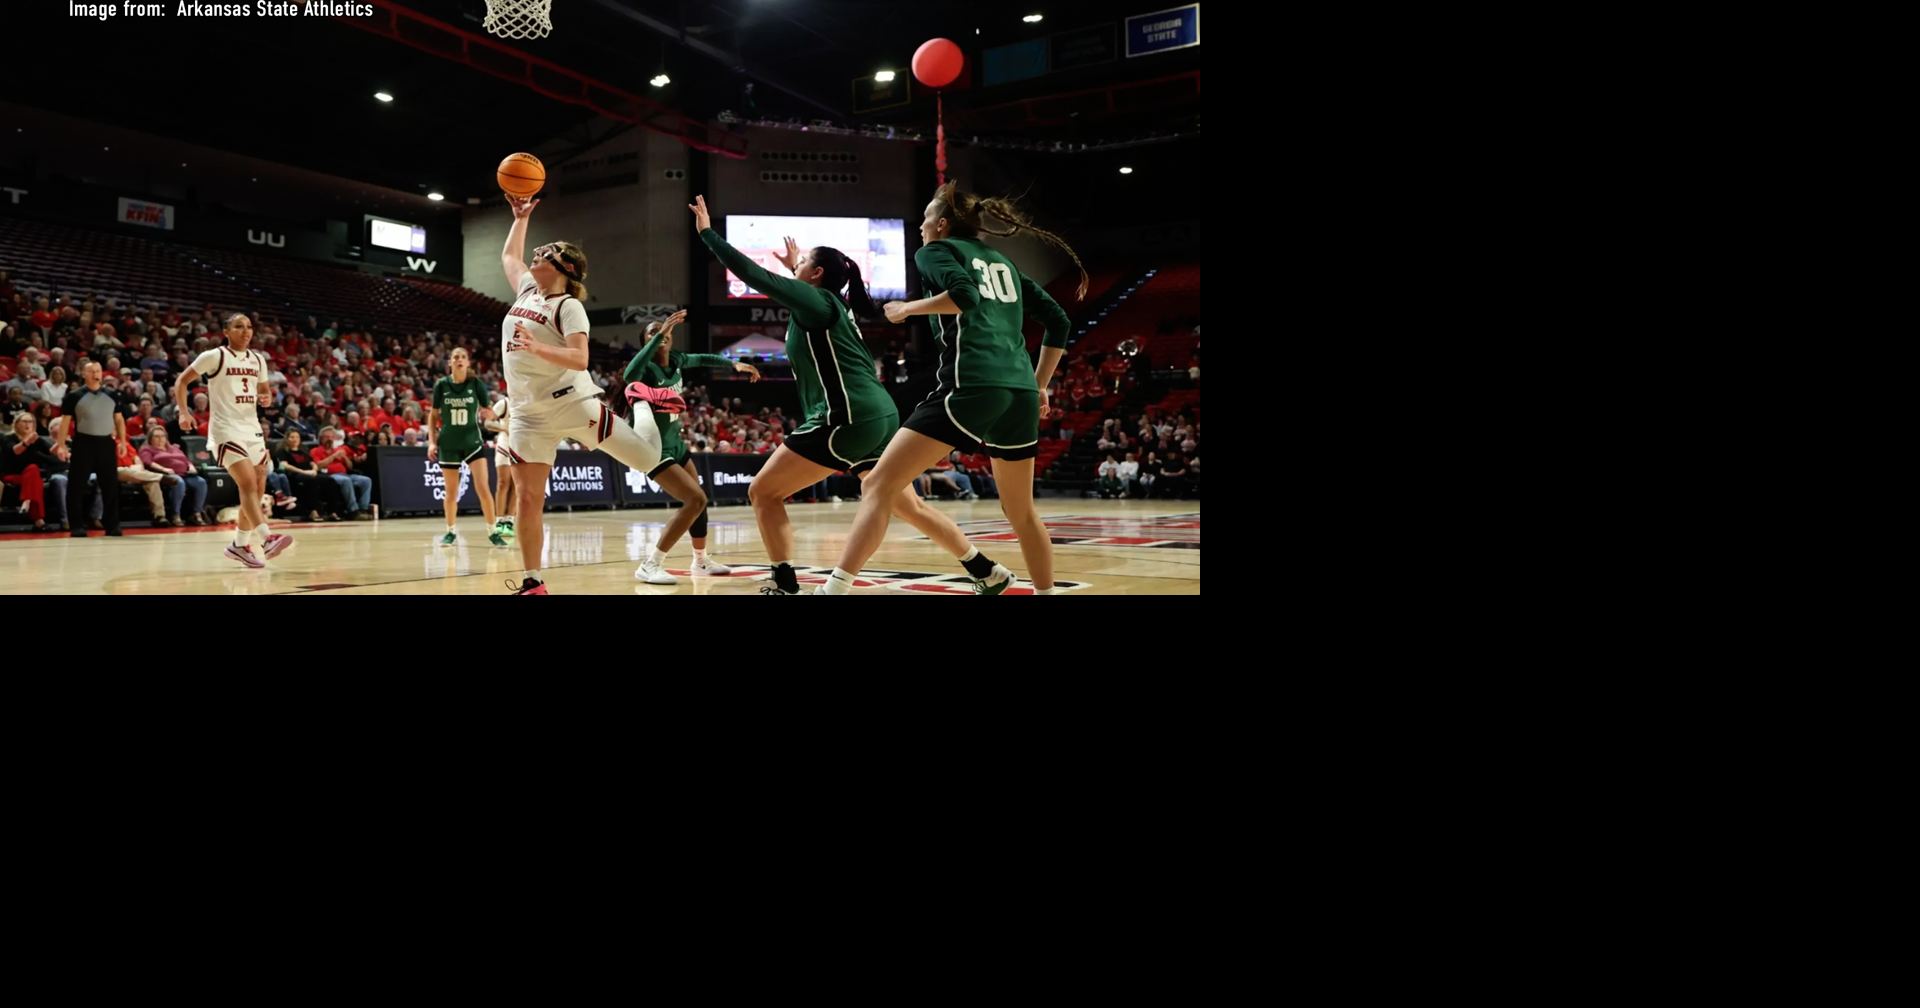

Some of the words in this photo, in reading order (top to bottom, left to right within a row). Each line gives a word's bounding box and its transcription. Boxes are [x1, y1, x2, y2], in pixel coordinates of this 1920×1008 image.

[1142, 18, 1183, 34] GEORGIA
[1147, 29, 1177, 44] STATE
[247, 229, 286, 248] UU
[972, 257, 1018, 303] 30
[751, 307, 790, 322] PAC
[242, 377, 249, 393] 3
[235, 395, 255, 404] STATE
[450, 408, 468, 426] 10
[551, 466, 603, 480] KALMER
[552, 481, 604, 491] SOLUTIONS
